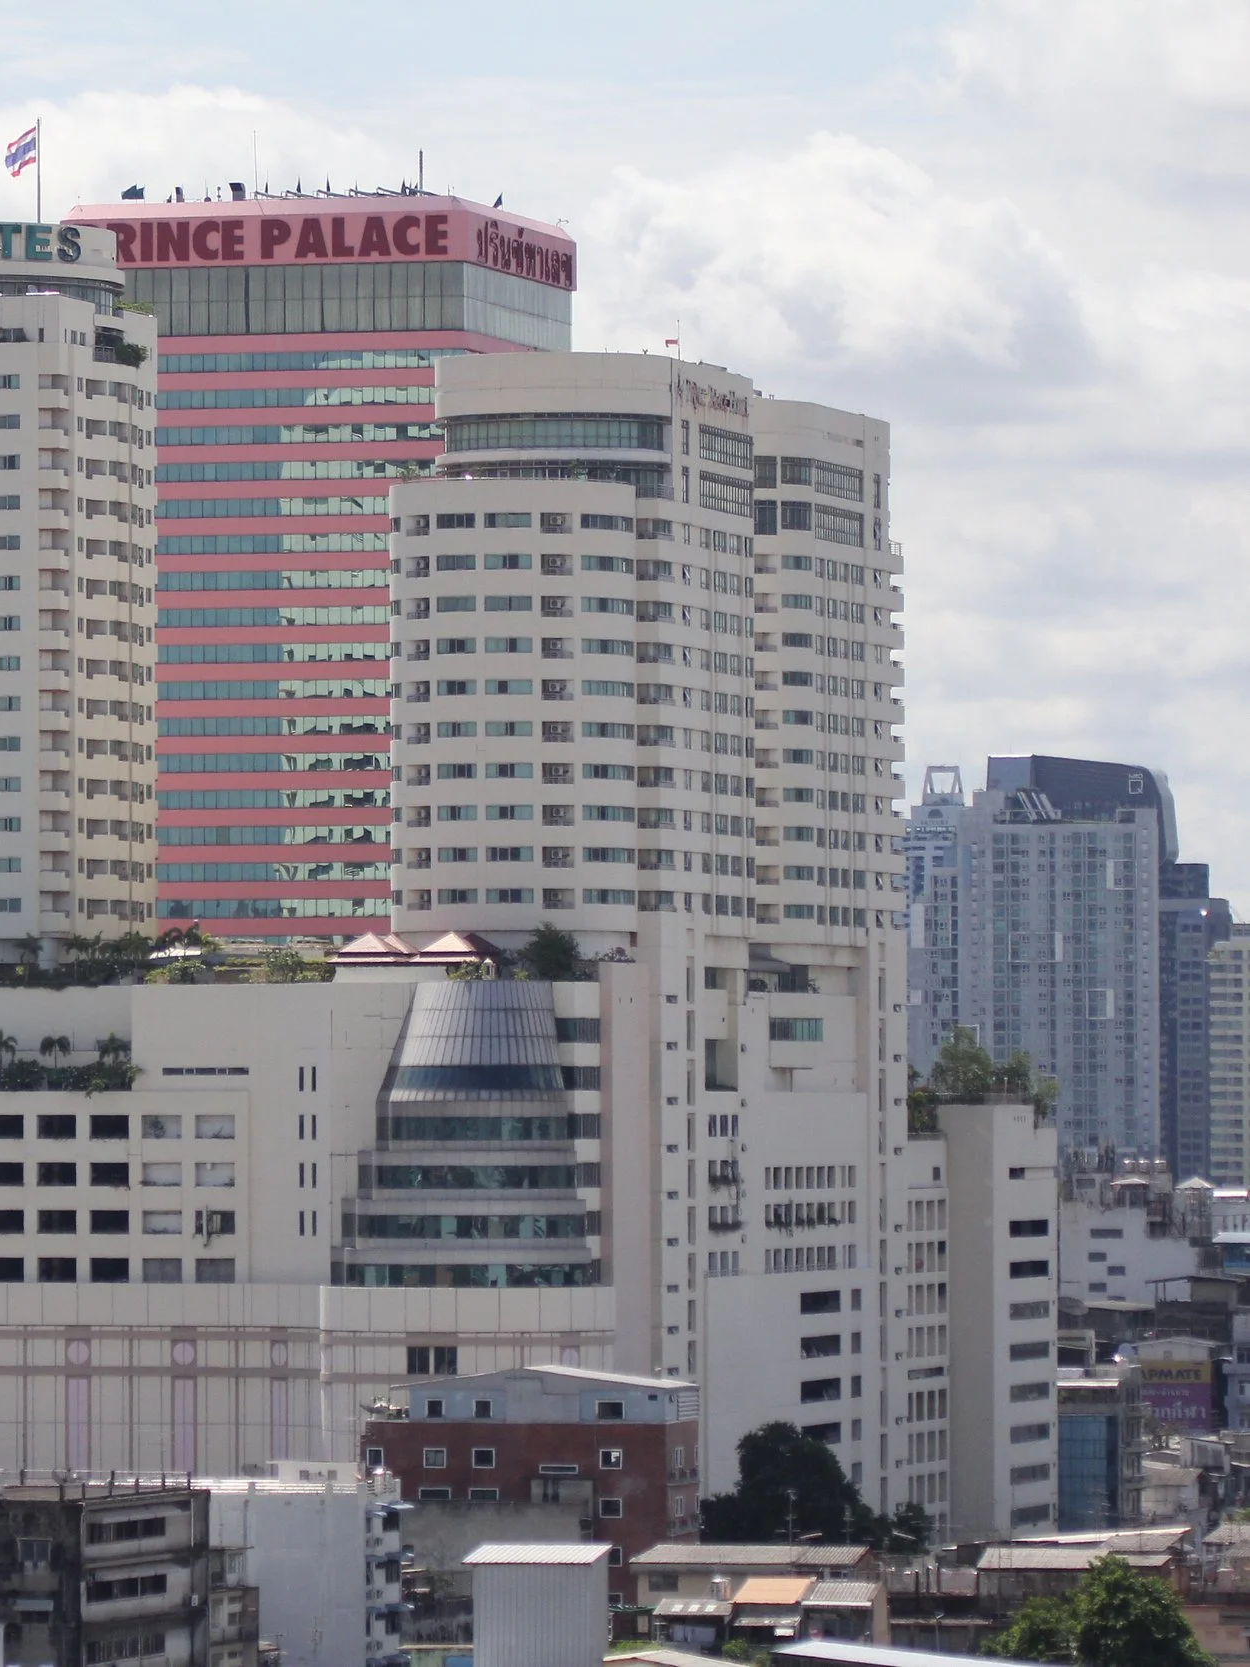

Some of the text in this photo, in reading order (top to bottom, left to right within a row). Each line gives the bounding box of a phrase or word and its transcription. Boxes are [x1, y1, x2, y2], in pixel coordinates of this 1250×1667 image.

[73, 214, 448, 263] RINCE PALACE
[1141, 1368, 1201, 1381] APMATE
